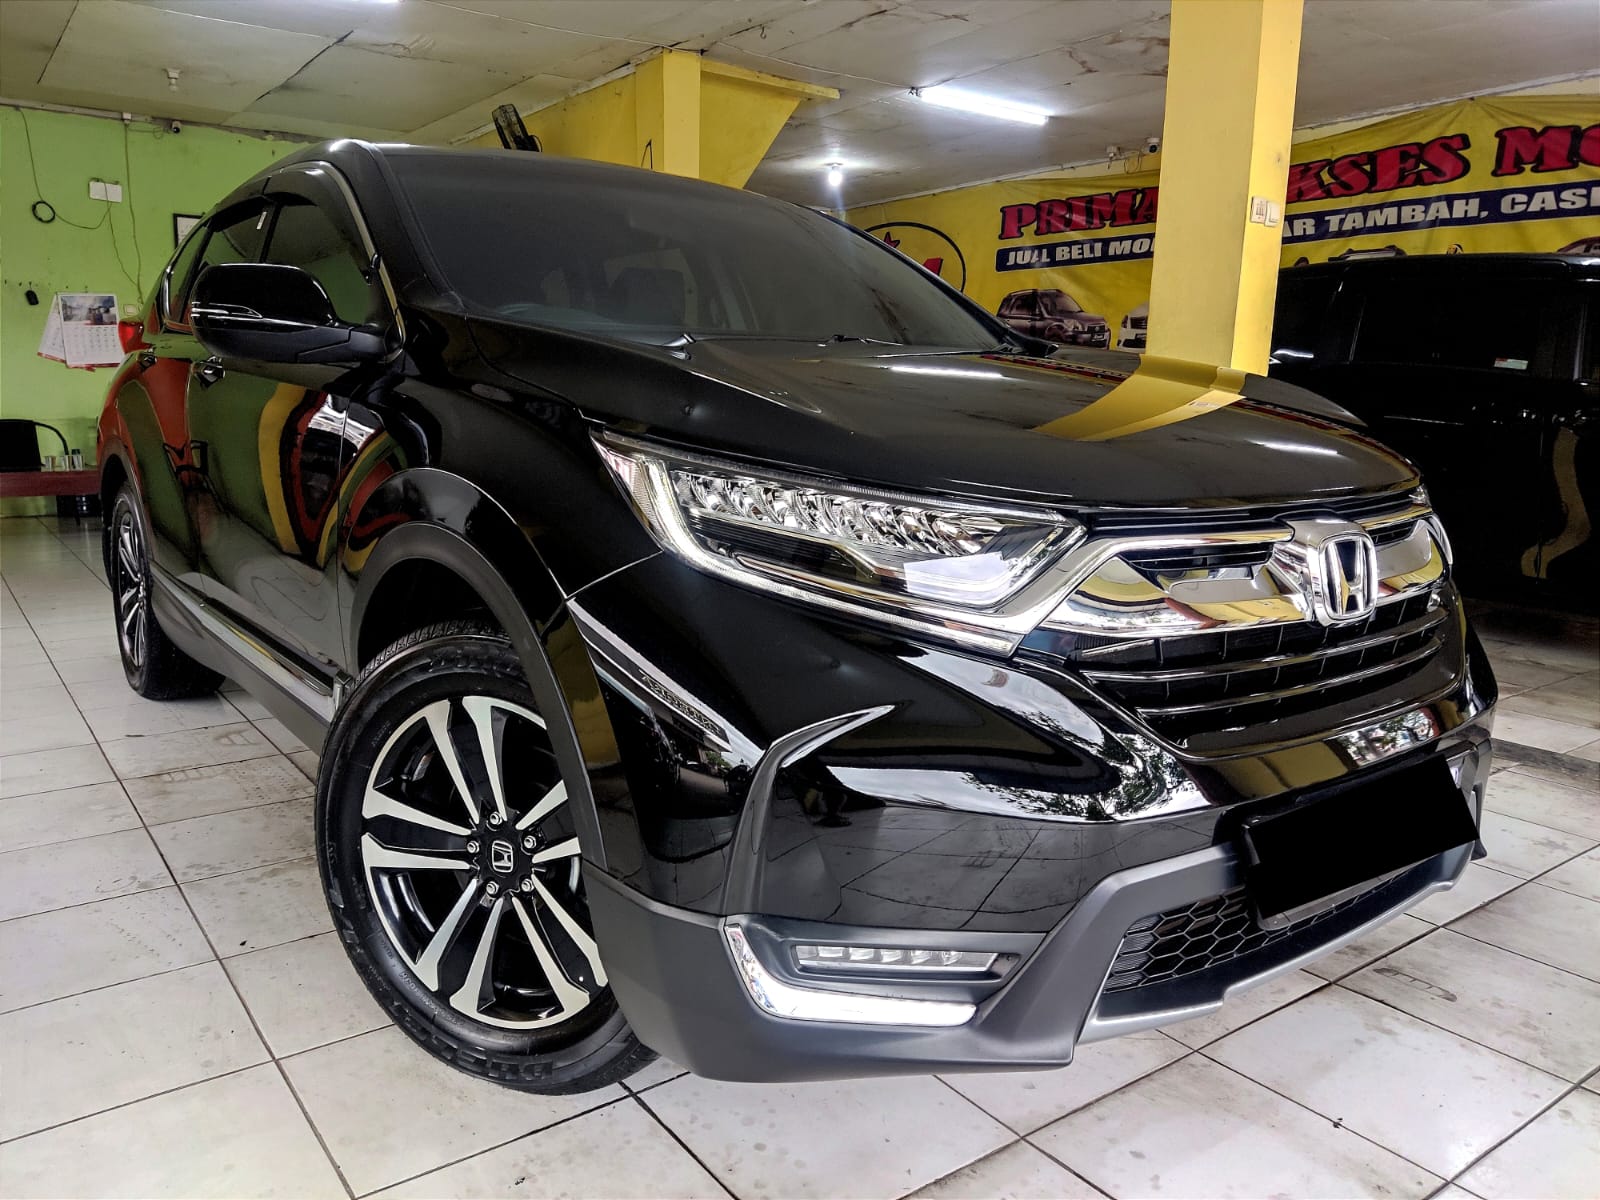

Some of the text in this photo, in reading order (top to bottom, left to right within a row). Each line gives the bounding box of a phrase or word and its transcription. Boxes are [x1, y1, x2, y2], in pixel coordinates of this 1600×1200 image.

[1006, 248, 1050, 266] JUAL
[1055, 243, 1102, 261] BELI
[1108, 238, 1155, 256] MO
[1325, 198, 1489, 232] TAMBAH,
